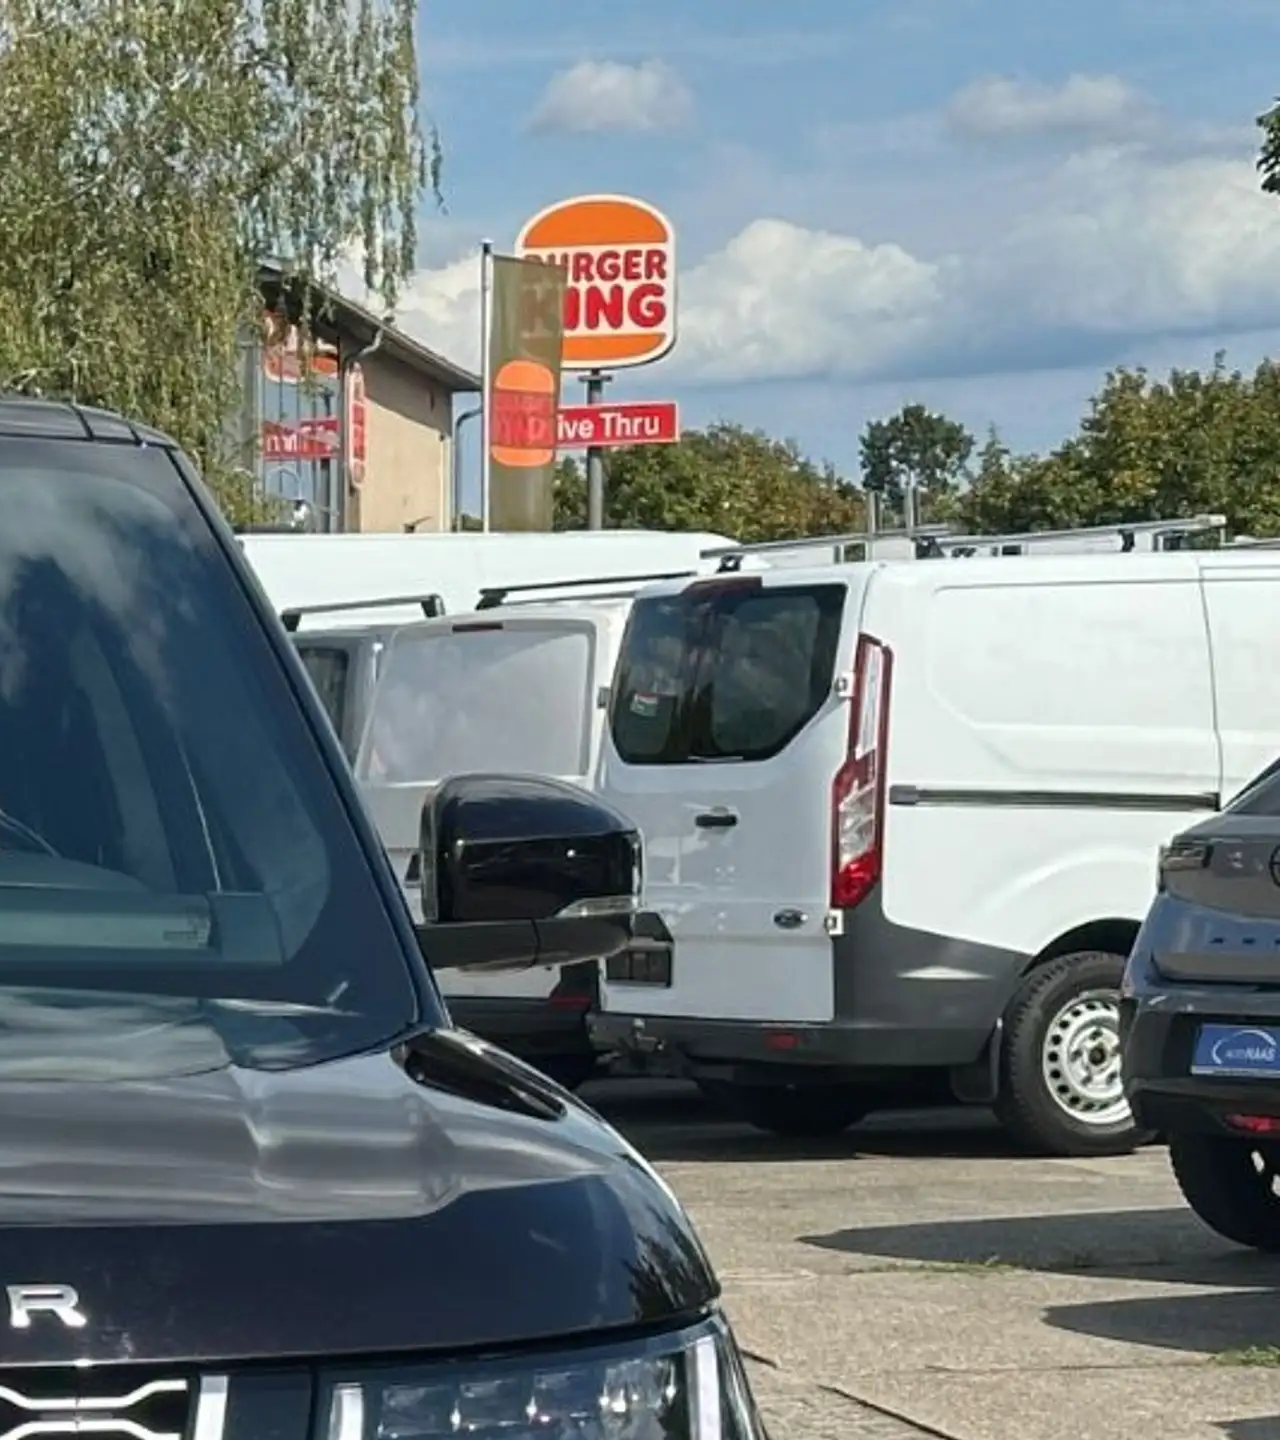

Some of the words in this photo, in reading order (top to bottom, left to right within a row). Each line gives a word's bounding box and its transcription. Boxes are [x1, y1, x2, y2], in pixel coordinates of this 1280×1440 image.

[523, 250, 667, 282] RGER
[523, 284, 666, 330] ING
[599, 411, 661, 438] Thru
